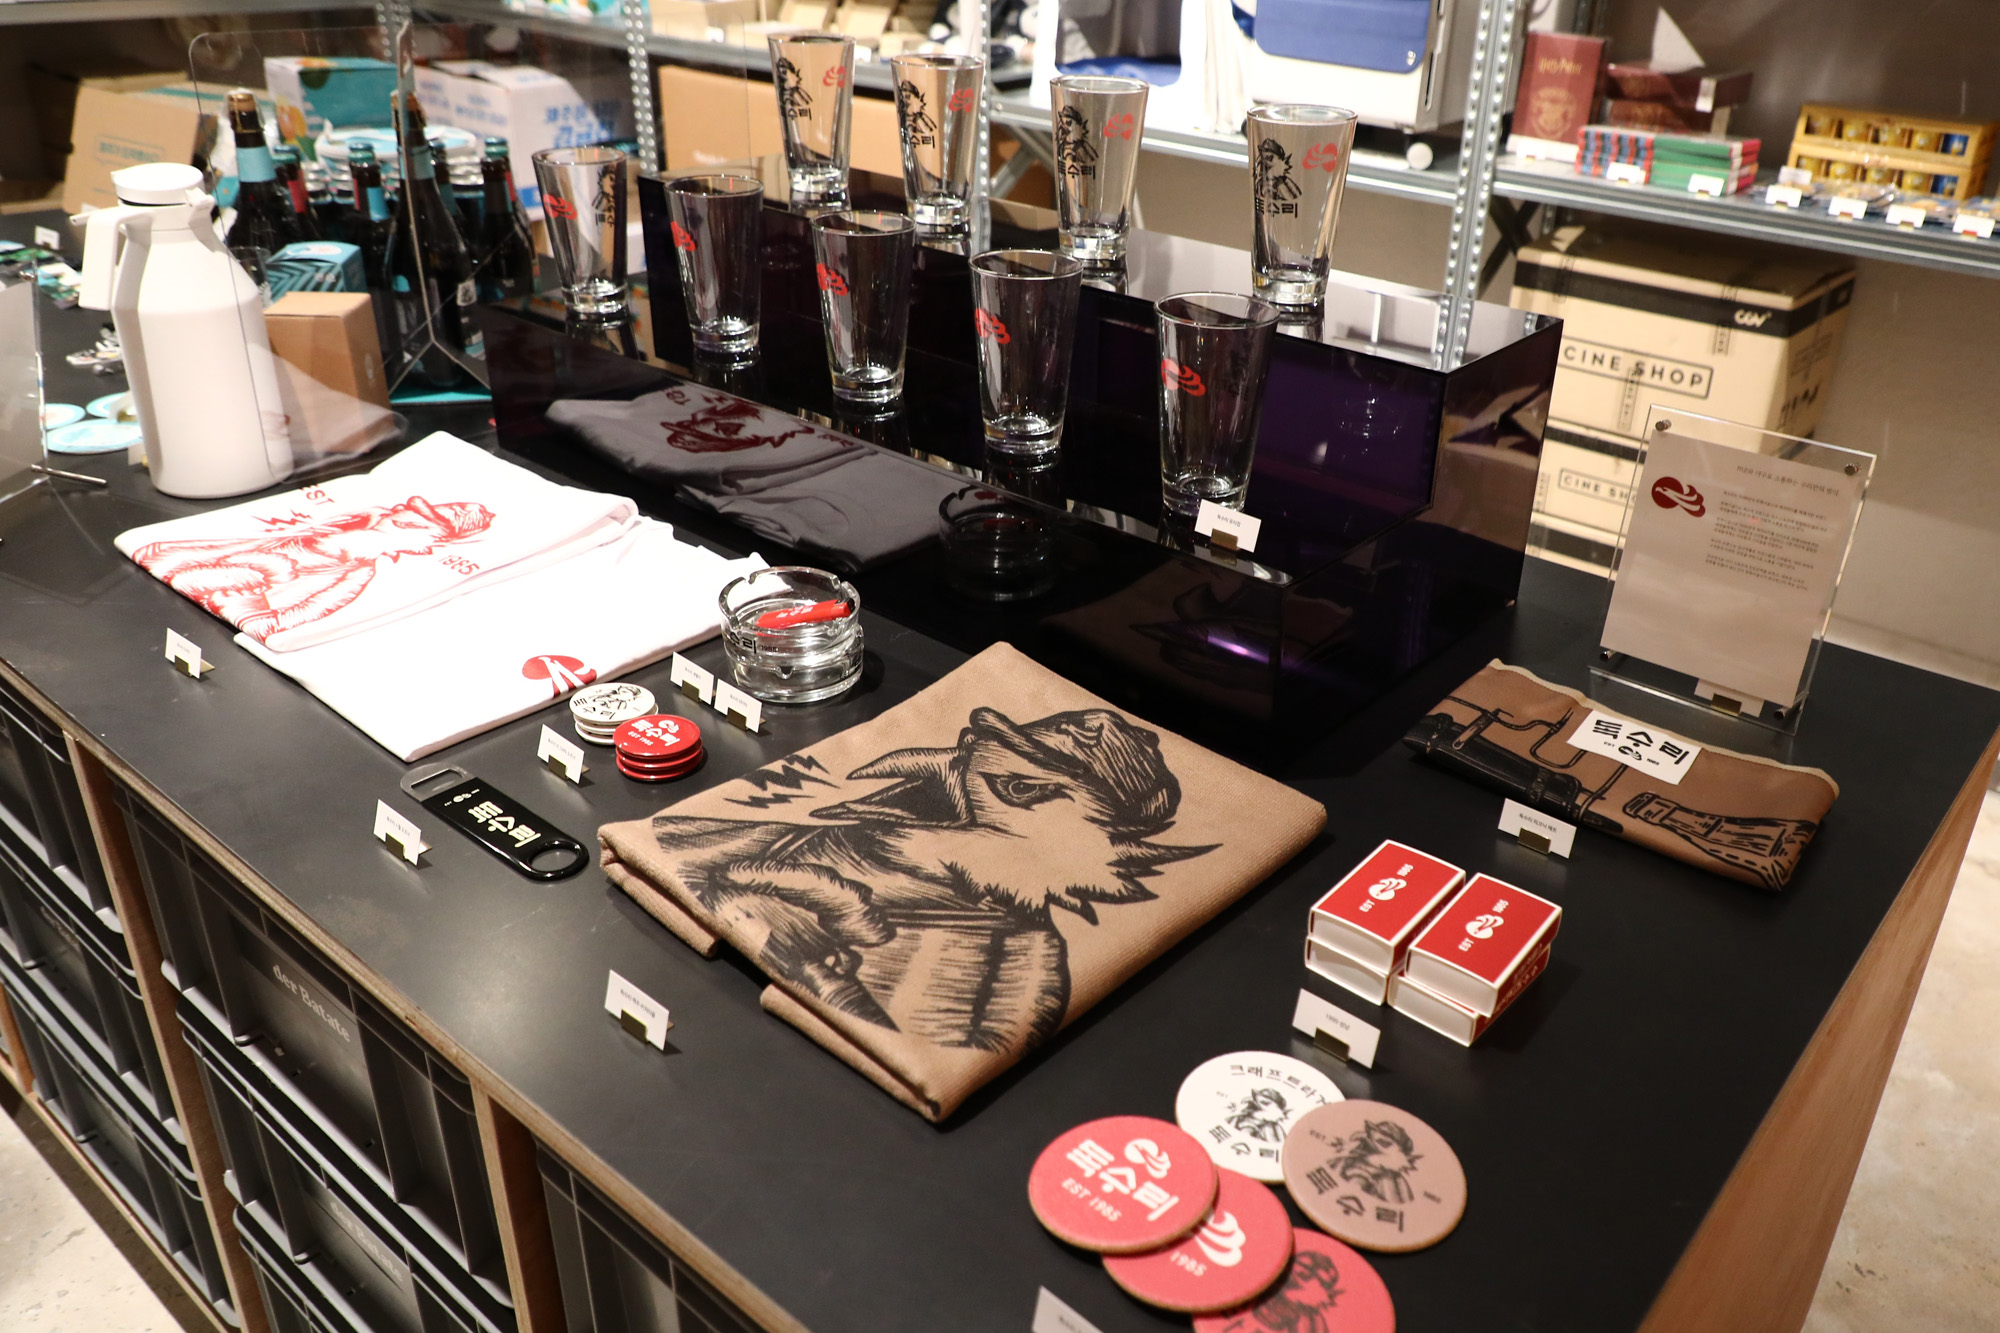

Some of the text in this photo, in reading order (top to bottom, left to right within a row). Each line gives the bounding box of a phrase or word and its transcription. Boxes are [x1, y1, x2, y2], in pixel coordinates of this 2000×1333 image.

[1563, 345, 1704, 388] CINE SHOP
[438, 554, 480, 576] 1985
[631, 719, 681, 747] 독수리
[1592, 719, 1690, 765] 독수리
[468, 801, 542, 848] 독수리
[1359, 863, 1414, 913] EST 1985
[1458, 898, 1510, 953] EST 1985
[272, 963, 352, 1043] der Batate
[1208, 1124, 1280, 1164] 독수리
[1061, 1177, 1122, 1222] EST 1985
[1066, 1138, 1180, 1222] 독수리
[1306, 1165, 1404, 1233] 독수리
[1169, 1249, 1208, 1278] 1985
